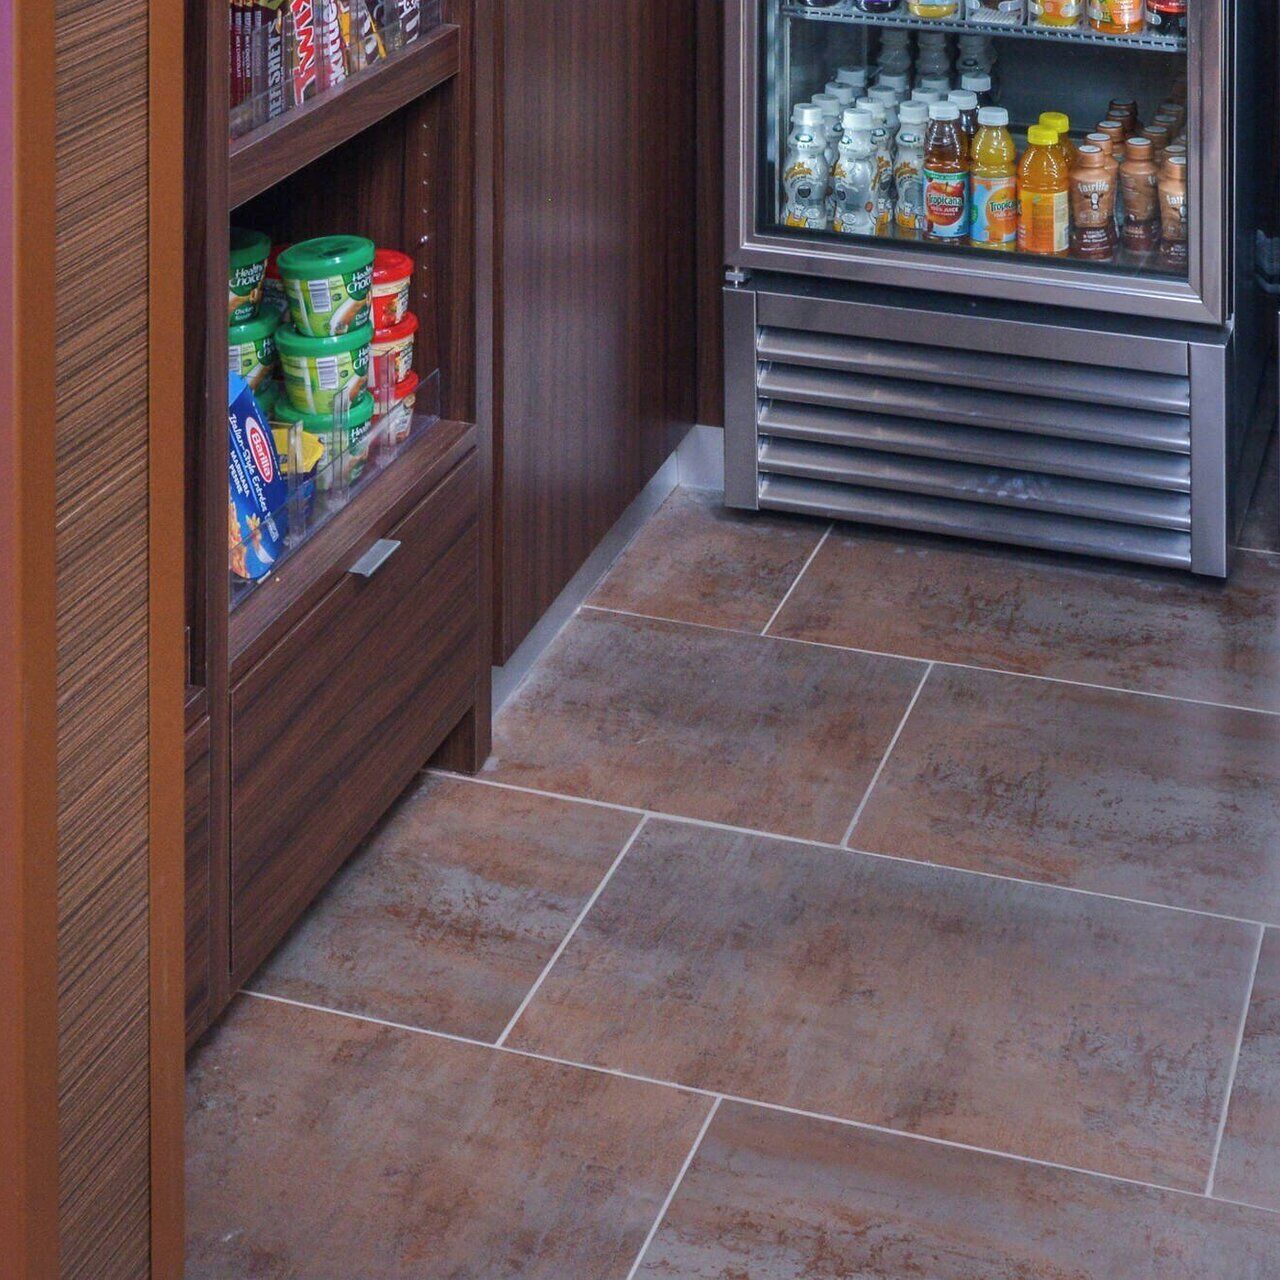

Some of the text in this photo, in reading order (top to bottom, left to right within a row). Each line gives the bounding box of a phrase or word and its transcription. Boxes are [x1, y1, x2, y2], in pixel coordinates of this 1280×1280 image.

[928, 193, 963, 206] Tropicana
[228, 413, 255, 475] Italian-Style
[250, 433, 271, 477] Barilla
[229, 464, 244, 495] PENNE
[230, 450, 250, 498] MARINARA
